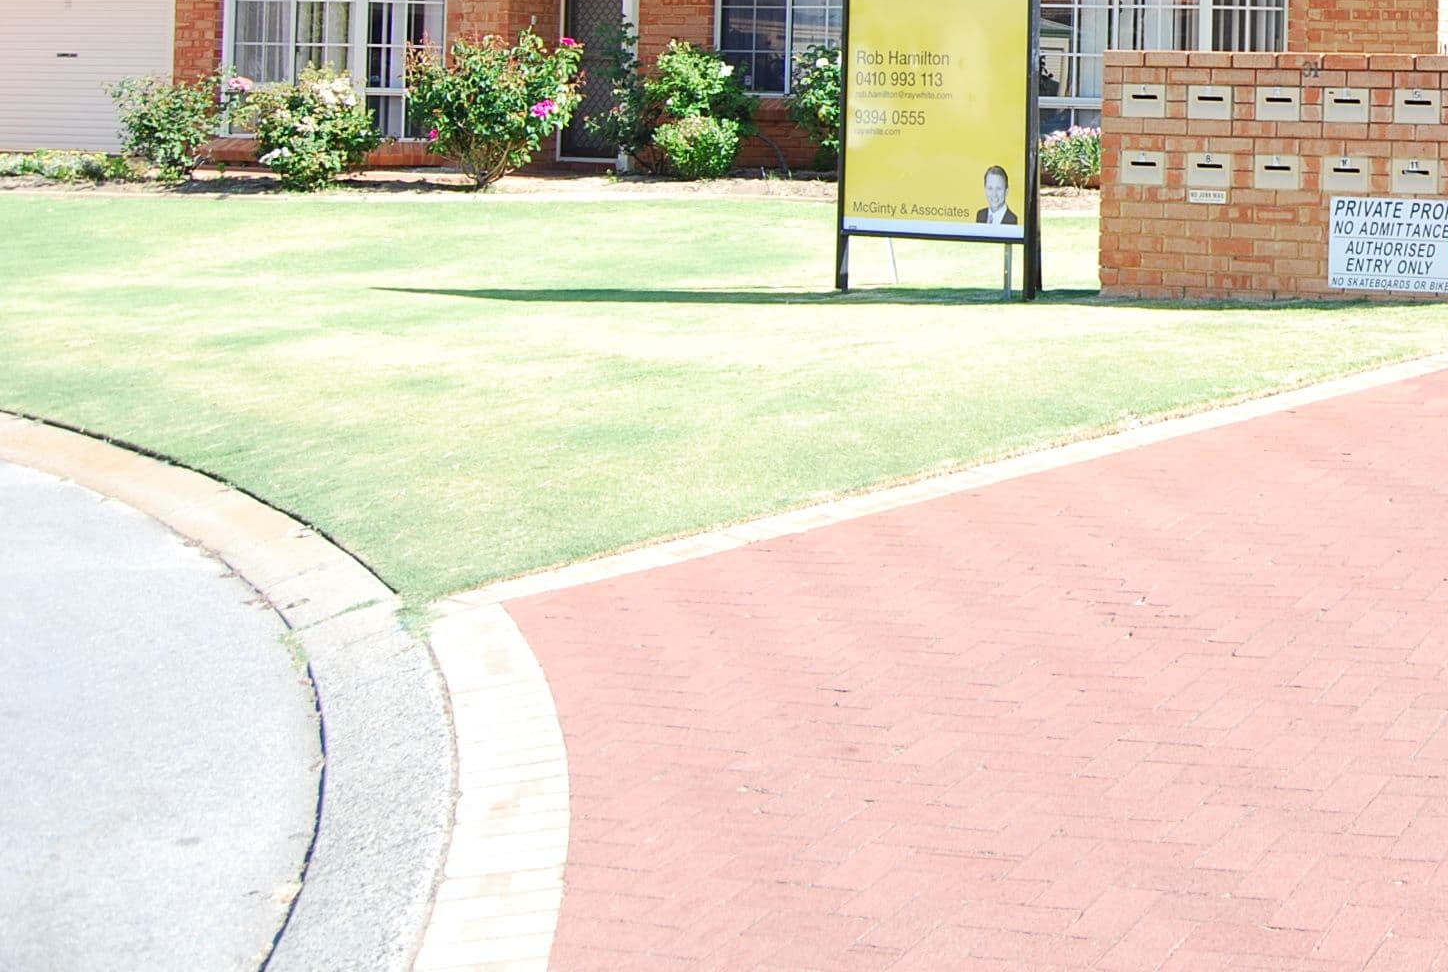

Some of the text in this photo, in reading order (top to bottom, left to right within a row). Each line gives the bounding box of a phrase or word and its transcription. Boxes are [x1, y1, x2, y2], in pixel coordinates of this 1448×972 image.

[856, 50, 950, 65] Rob Hamilton
[856, 71, 943, 87] 0410 993 113
[854, 109, 925, 125] 9394 0555
[852, 201, 970, 218] McGinty & Associates
[1334, 200, 1403, 219] PRIVATE
[1334, 220, 1354, 235] NO
[1345, 240, 1436, 258] AUTHORISED
[1345, 258, 1433, 275] ENTRY ONLY
[1332, 277, 1344, 286] NO
[1347, 278, 1411, 290] SKATEBOARDS
[1414, 280, 1426, 289] OR
